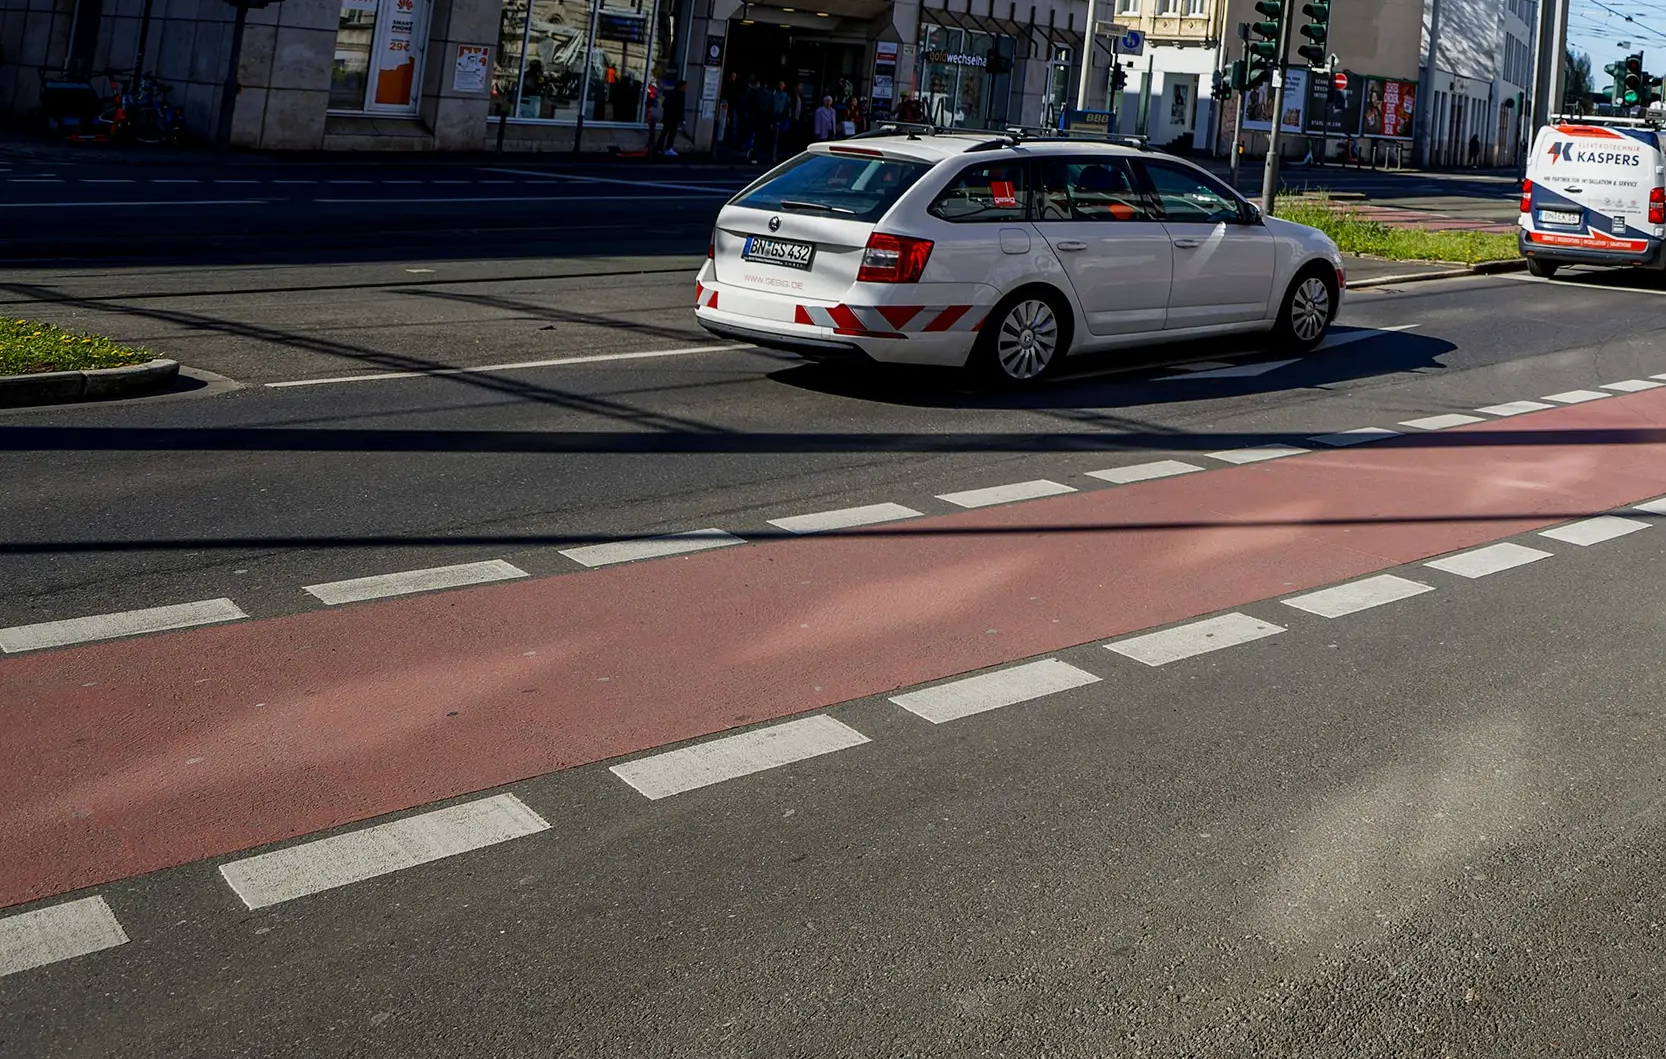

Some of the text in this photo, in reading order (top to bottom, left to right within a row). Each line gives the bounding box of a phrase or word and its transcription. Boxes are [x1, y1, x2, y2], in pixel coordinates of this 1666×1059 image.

[389, 42, 410, 52] 29€
[1086, 114, 1110, 123] BBB
[1578, 142, 1641, 152] ELEKTROTECHNIK
[1577, 151, 1640, 167] KASPERS
[750, 238, 810, 262] BN GS 432
[744, 274, 804, 290] WWW.GESIG.DE
